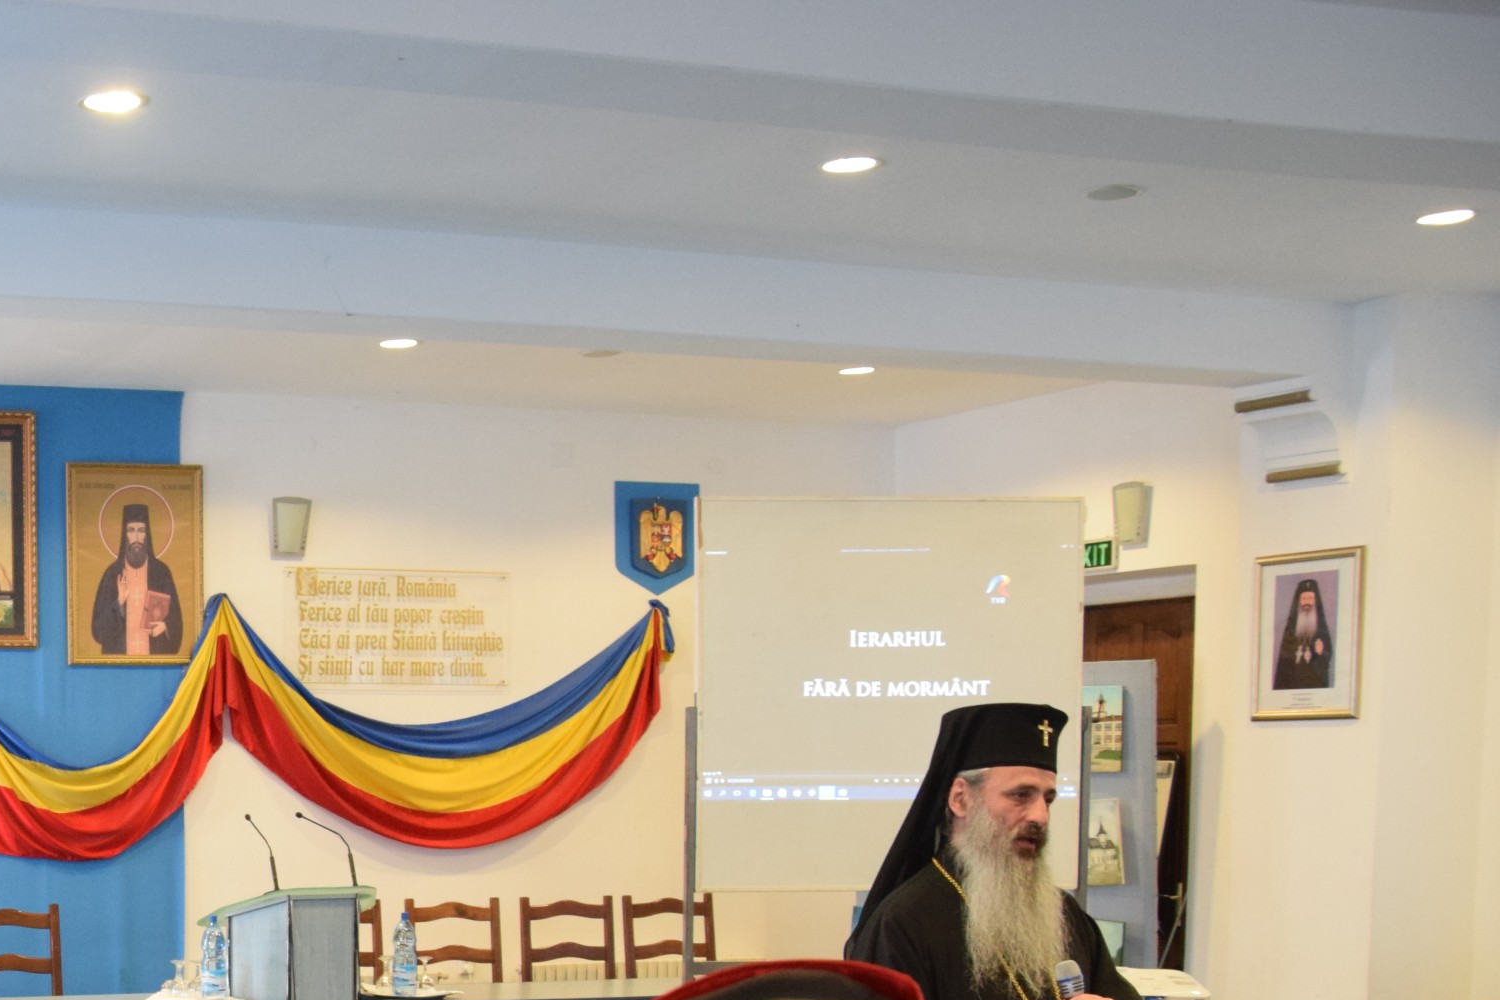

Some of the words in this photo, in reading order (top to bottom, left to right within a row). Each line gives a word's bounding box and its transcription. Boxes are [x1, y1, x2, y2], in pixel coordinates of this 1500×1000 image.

[1083, 543, 1109, 568] XIT
[397, 575, 456, 598] România
[299, 600, 342, 622] Ferice
[348, 603, 360, 622] al
[394, 607, 432, 627] popor
[337, 630, 350, 649] ai
[356, 634, 386, 653] prea
[849, 629, 947, 648] IERARHUL
[359, 660, 374, 676] cu
[382, 657, 405, 676] har
[411, 660, 444, 677] mare
[802, 678, 851, 697] FĂRĂ
[856, 681, 881, 697] DE
[887, 677, 991, 697] MORMÂNT
